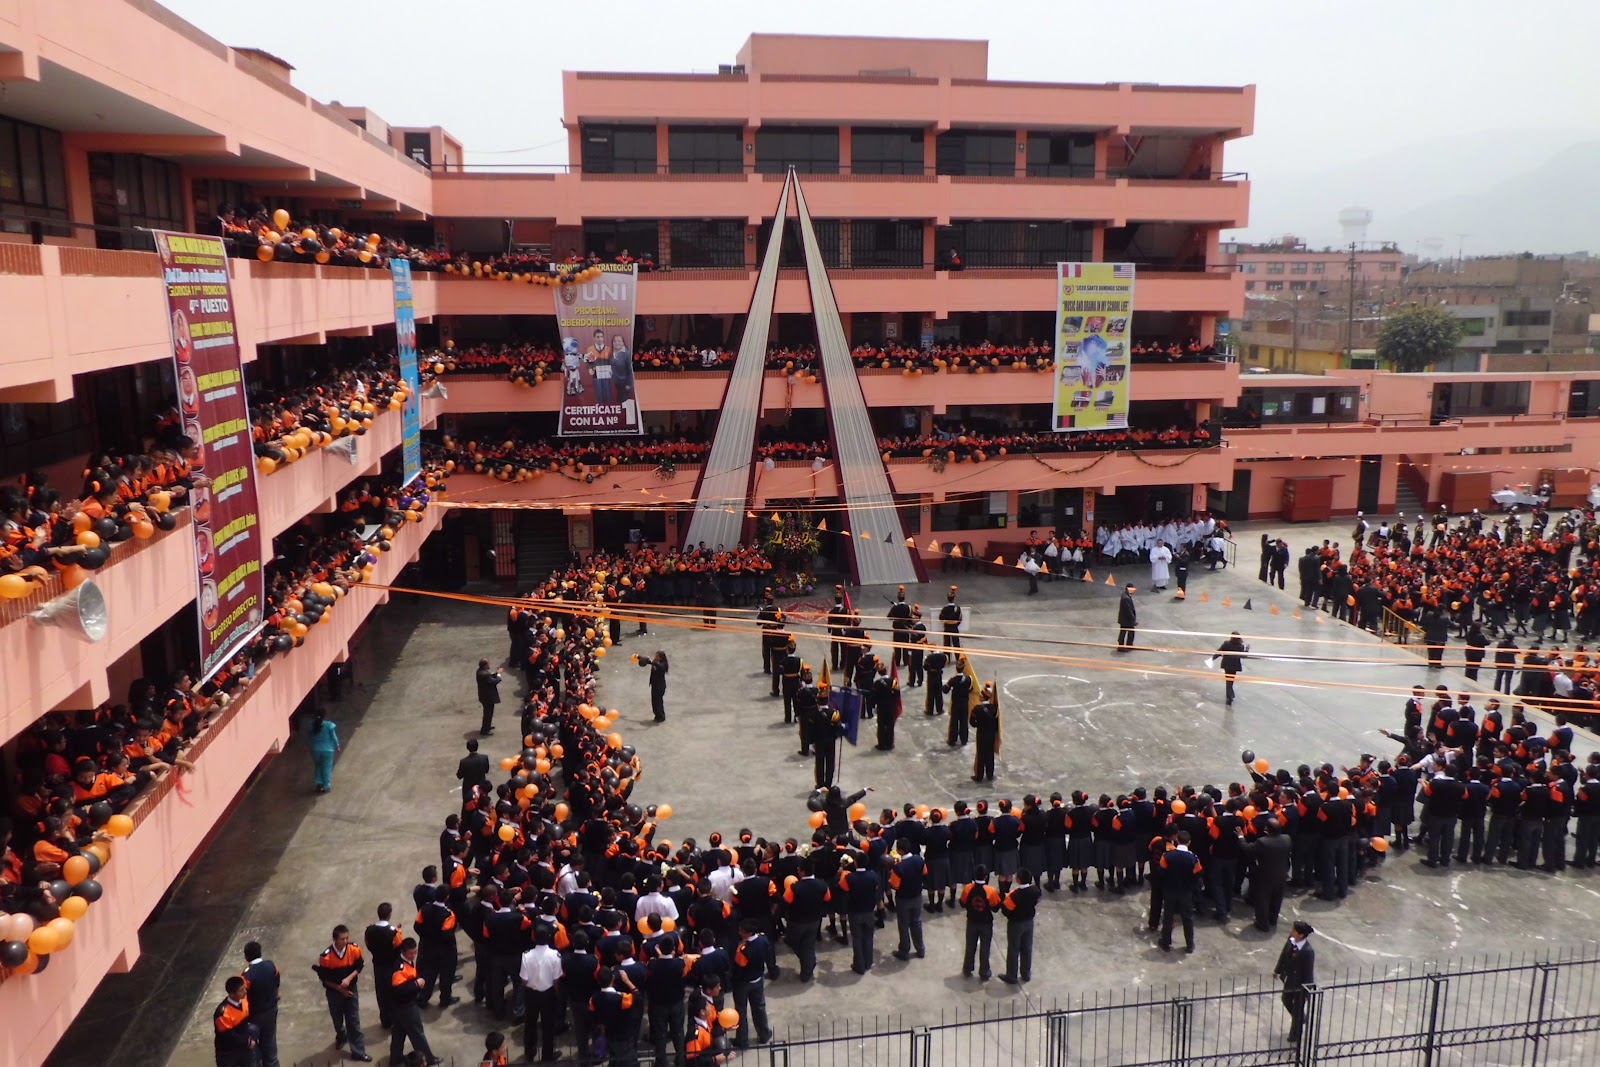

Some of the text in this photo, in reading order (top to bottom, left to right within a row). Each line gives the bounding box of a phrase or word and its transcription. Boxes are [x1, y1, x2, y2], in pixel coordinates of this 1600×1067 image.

[582, 283, 627, 302] UNI
[200, 298, 229, 314] PUESTO
[575, 306, 617, 315] PROGRAMA
[560, 318, 630, 327] CIBERDOMINGUINO
[564, 403, 622, 415] CERTIFÍCATE
[569, 416, 590, 426] CON
[592, 416, 605, 426] LA
[621, 398, 637, 425] 1
